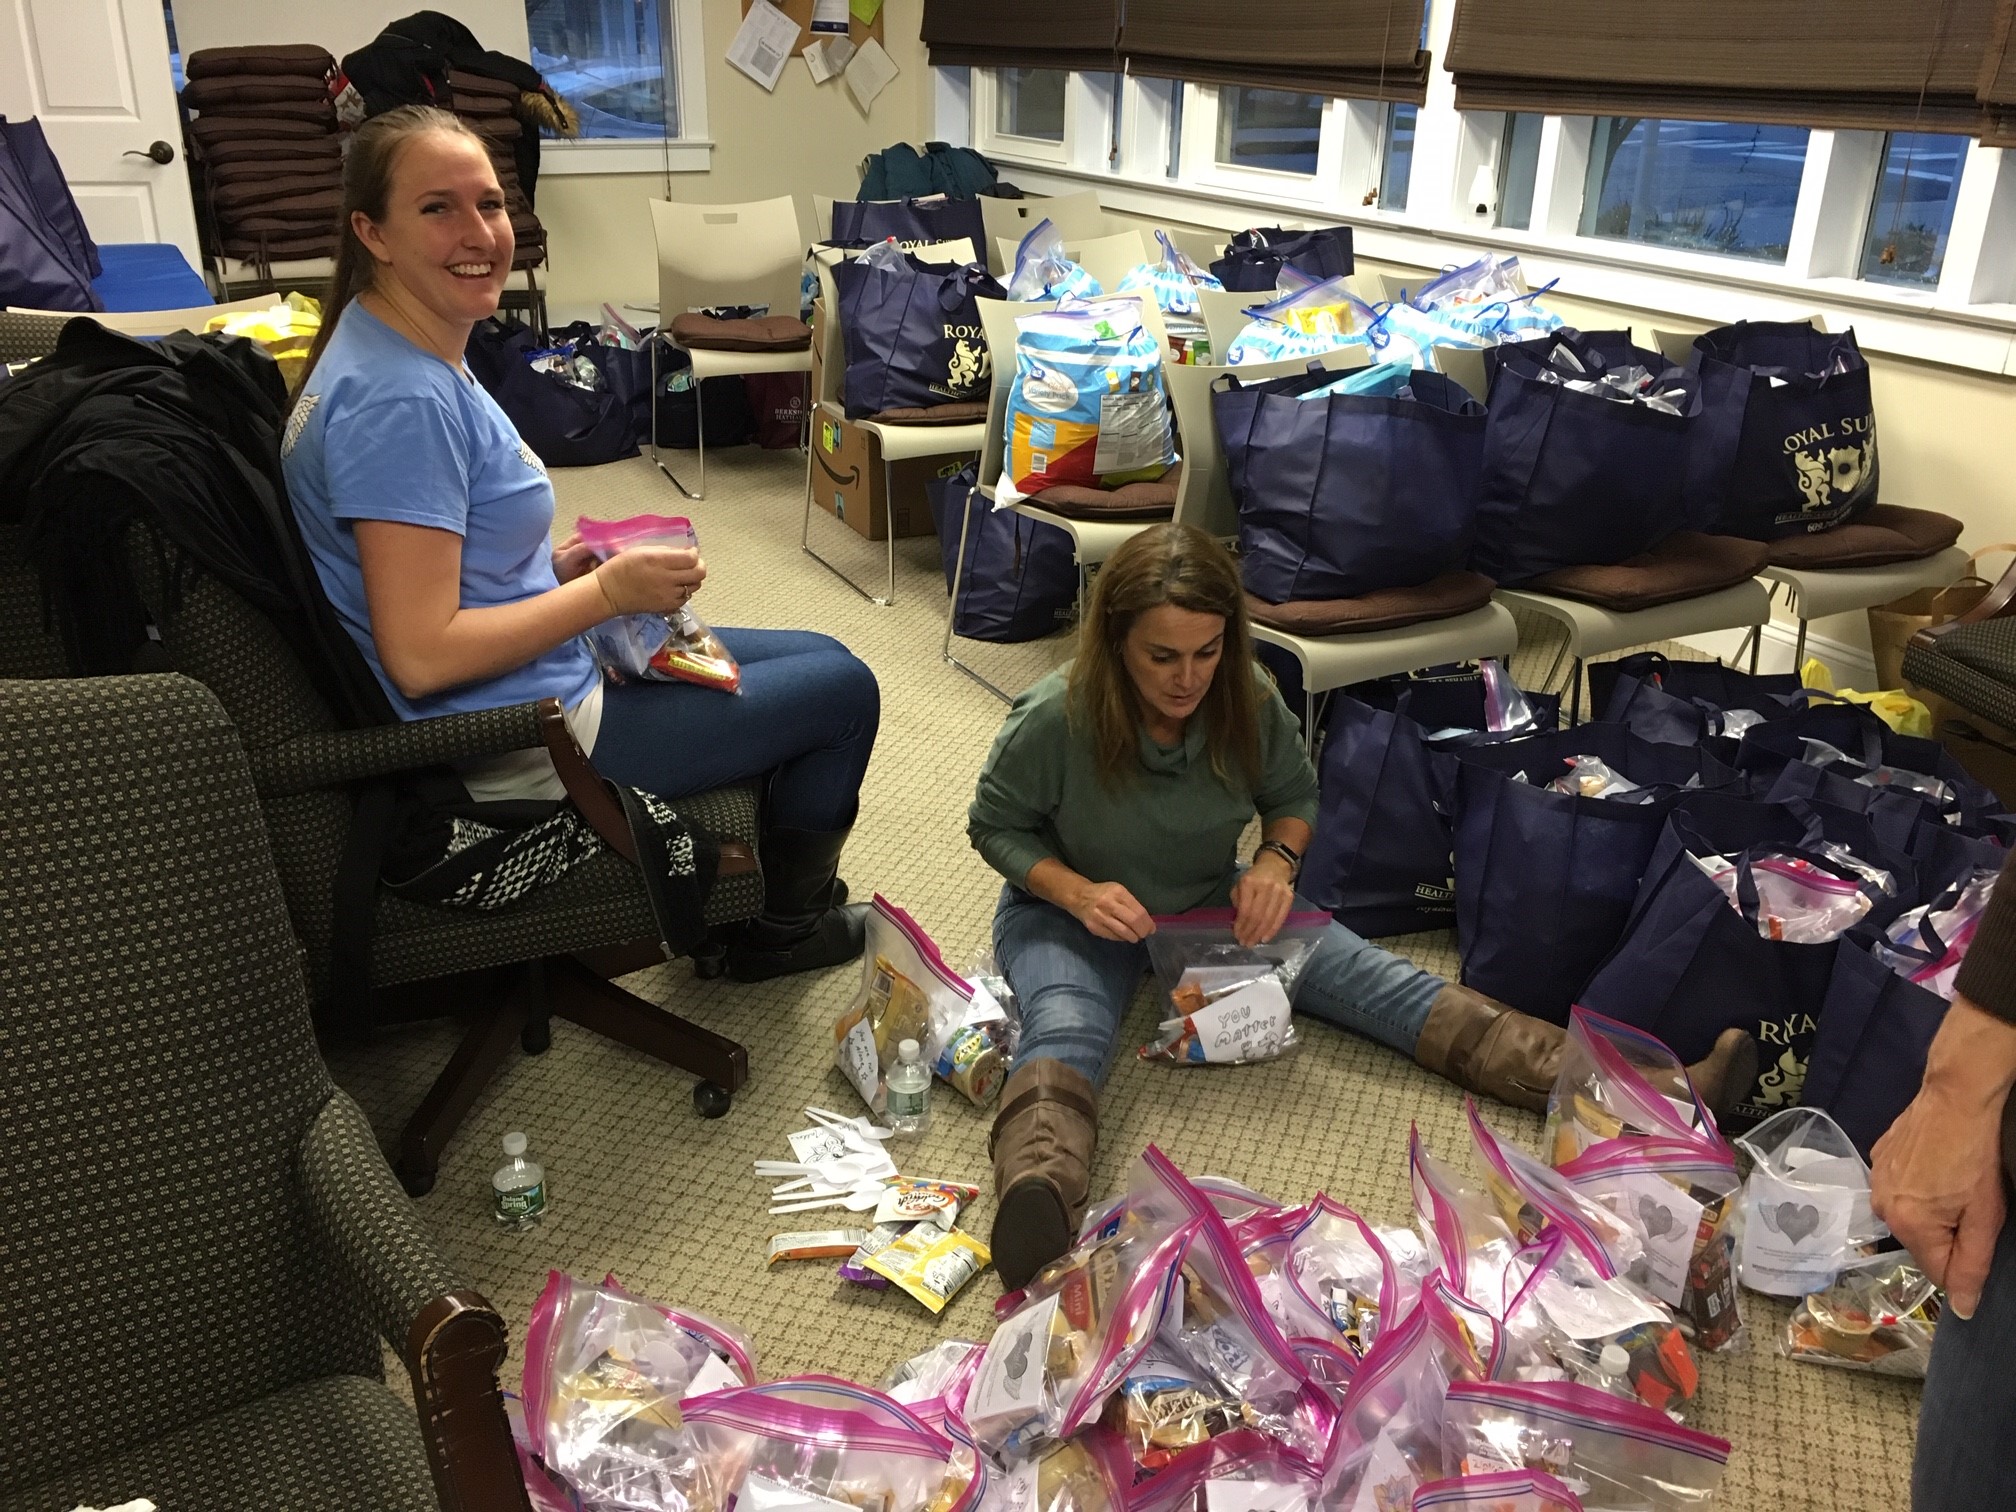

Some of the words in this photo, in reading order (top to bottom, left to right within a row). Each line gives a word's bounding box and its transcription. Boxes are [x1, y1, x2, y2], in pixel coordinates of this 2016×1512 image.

[943, 324, 987, 339] ROYA
[1783, 423, 1835, 454] OYAL
[1415, 885, 1455, 898] HEALT
[1217, 1005, 1251, 1029] YOU
[1074, 1283, 1086, 1316] Mini
